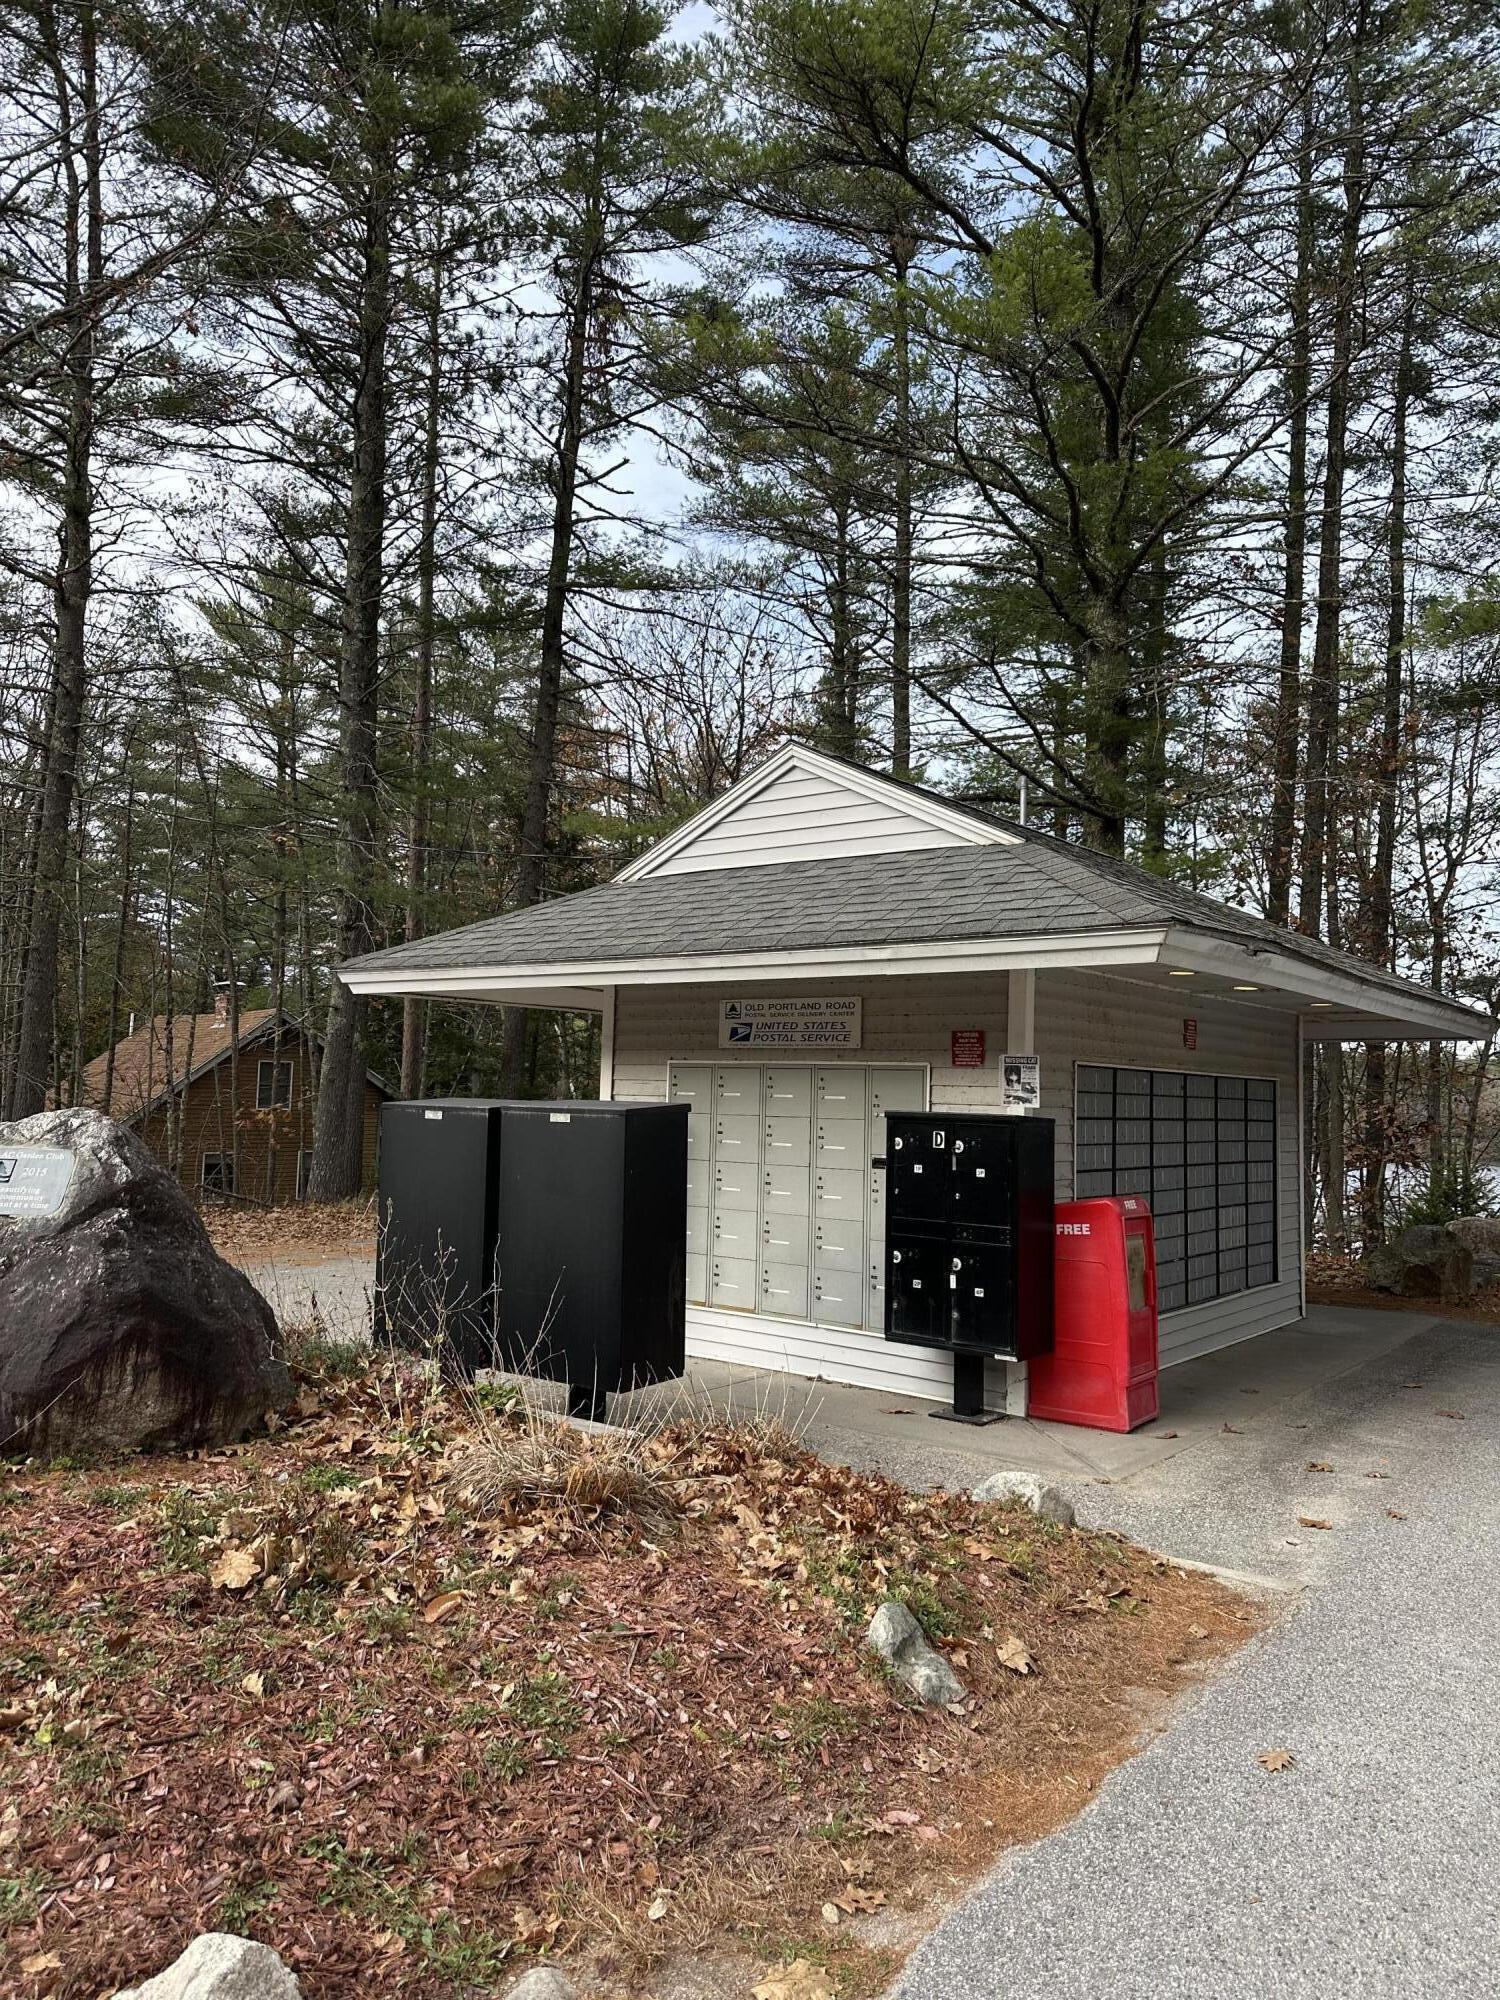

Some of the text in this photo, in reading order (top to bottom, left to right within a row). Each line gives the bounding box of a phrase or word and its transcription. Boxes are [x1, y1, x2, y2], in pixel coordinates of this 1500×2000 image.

[745, 1001, 856, 1011] OLD PORTLAND ROAD
[756, 1021, 847, 1030] UNITED STATES
[753, 1033, 851, 1042] POSTAL SERVICE
[934, 1132, 944, 1147] D
[1124, 1200, 1137, 1210] FREE
[1056, 1224, 1091, 1235] FREE
